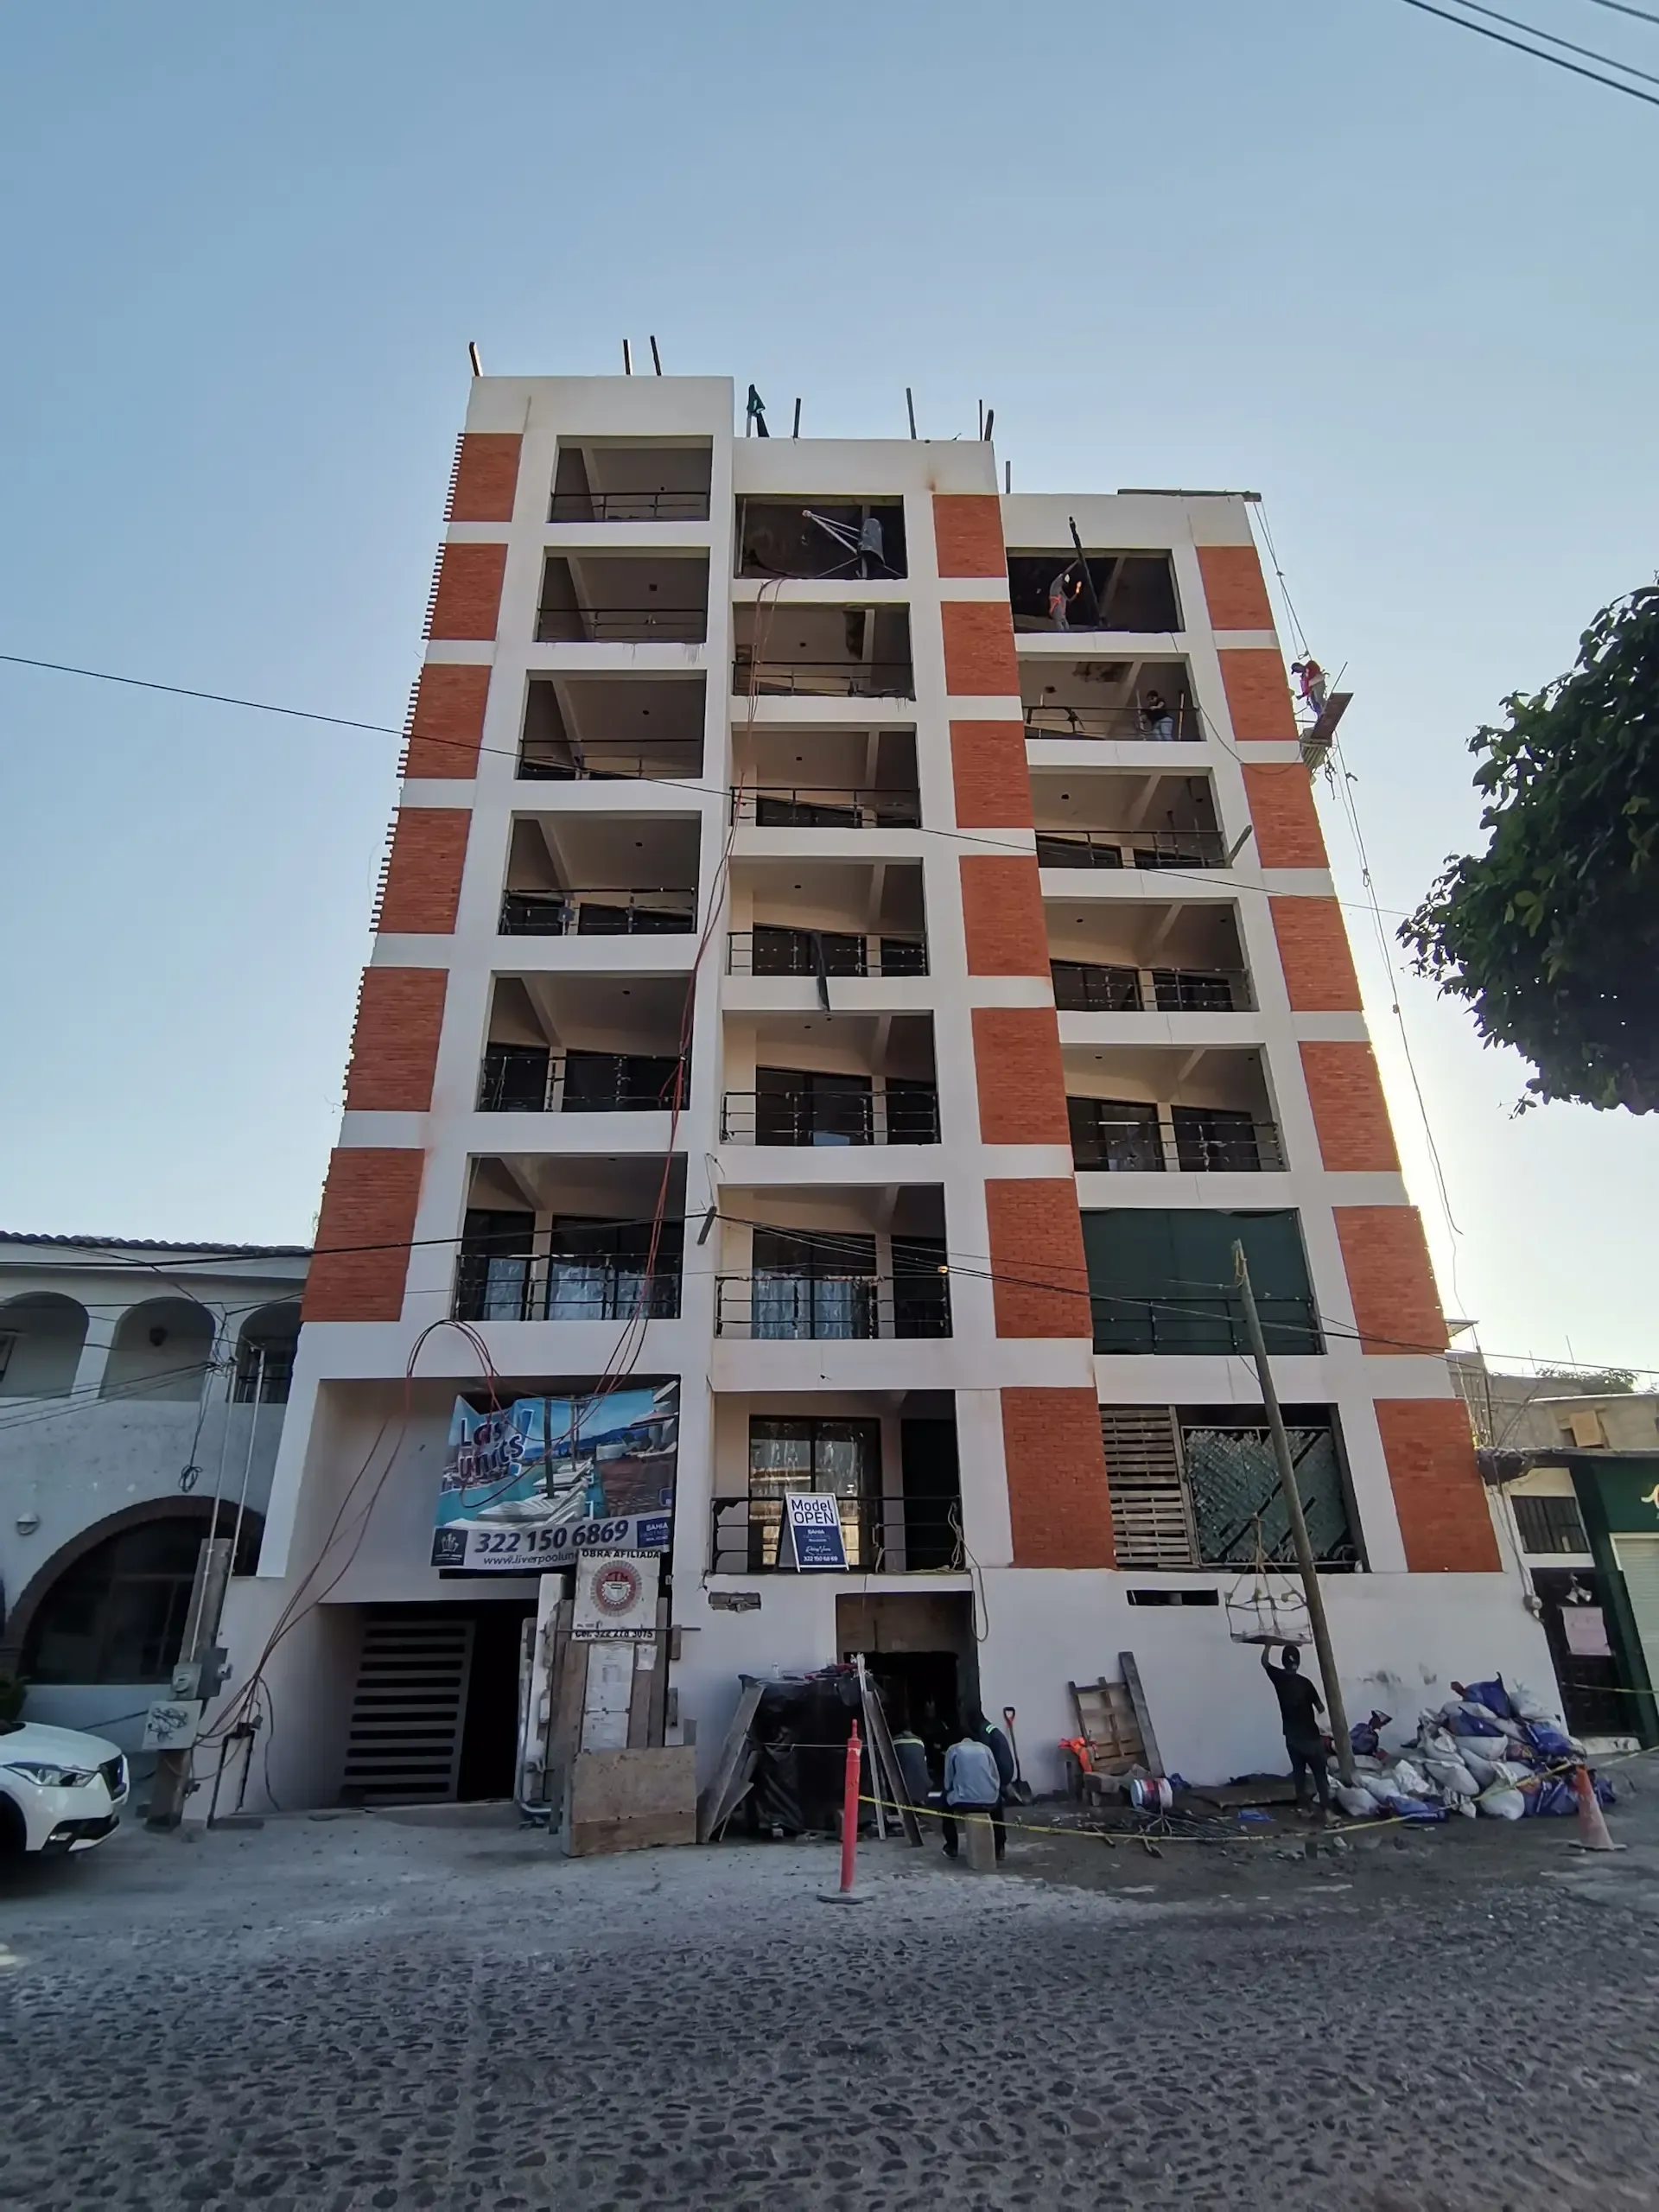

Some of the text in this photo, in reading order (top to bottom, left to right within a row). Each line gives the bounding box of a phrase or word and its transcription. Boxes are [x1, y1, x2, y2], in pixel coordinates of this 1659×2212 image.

[791, 1498, 833, 1512] Model
[793, 1512, 835, 1525] OPEN
[474, 1519, 629, 1553] 322 150 6869
[582, 1548, 660, 1558] OBRA AFILIADA
